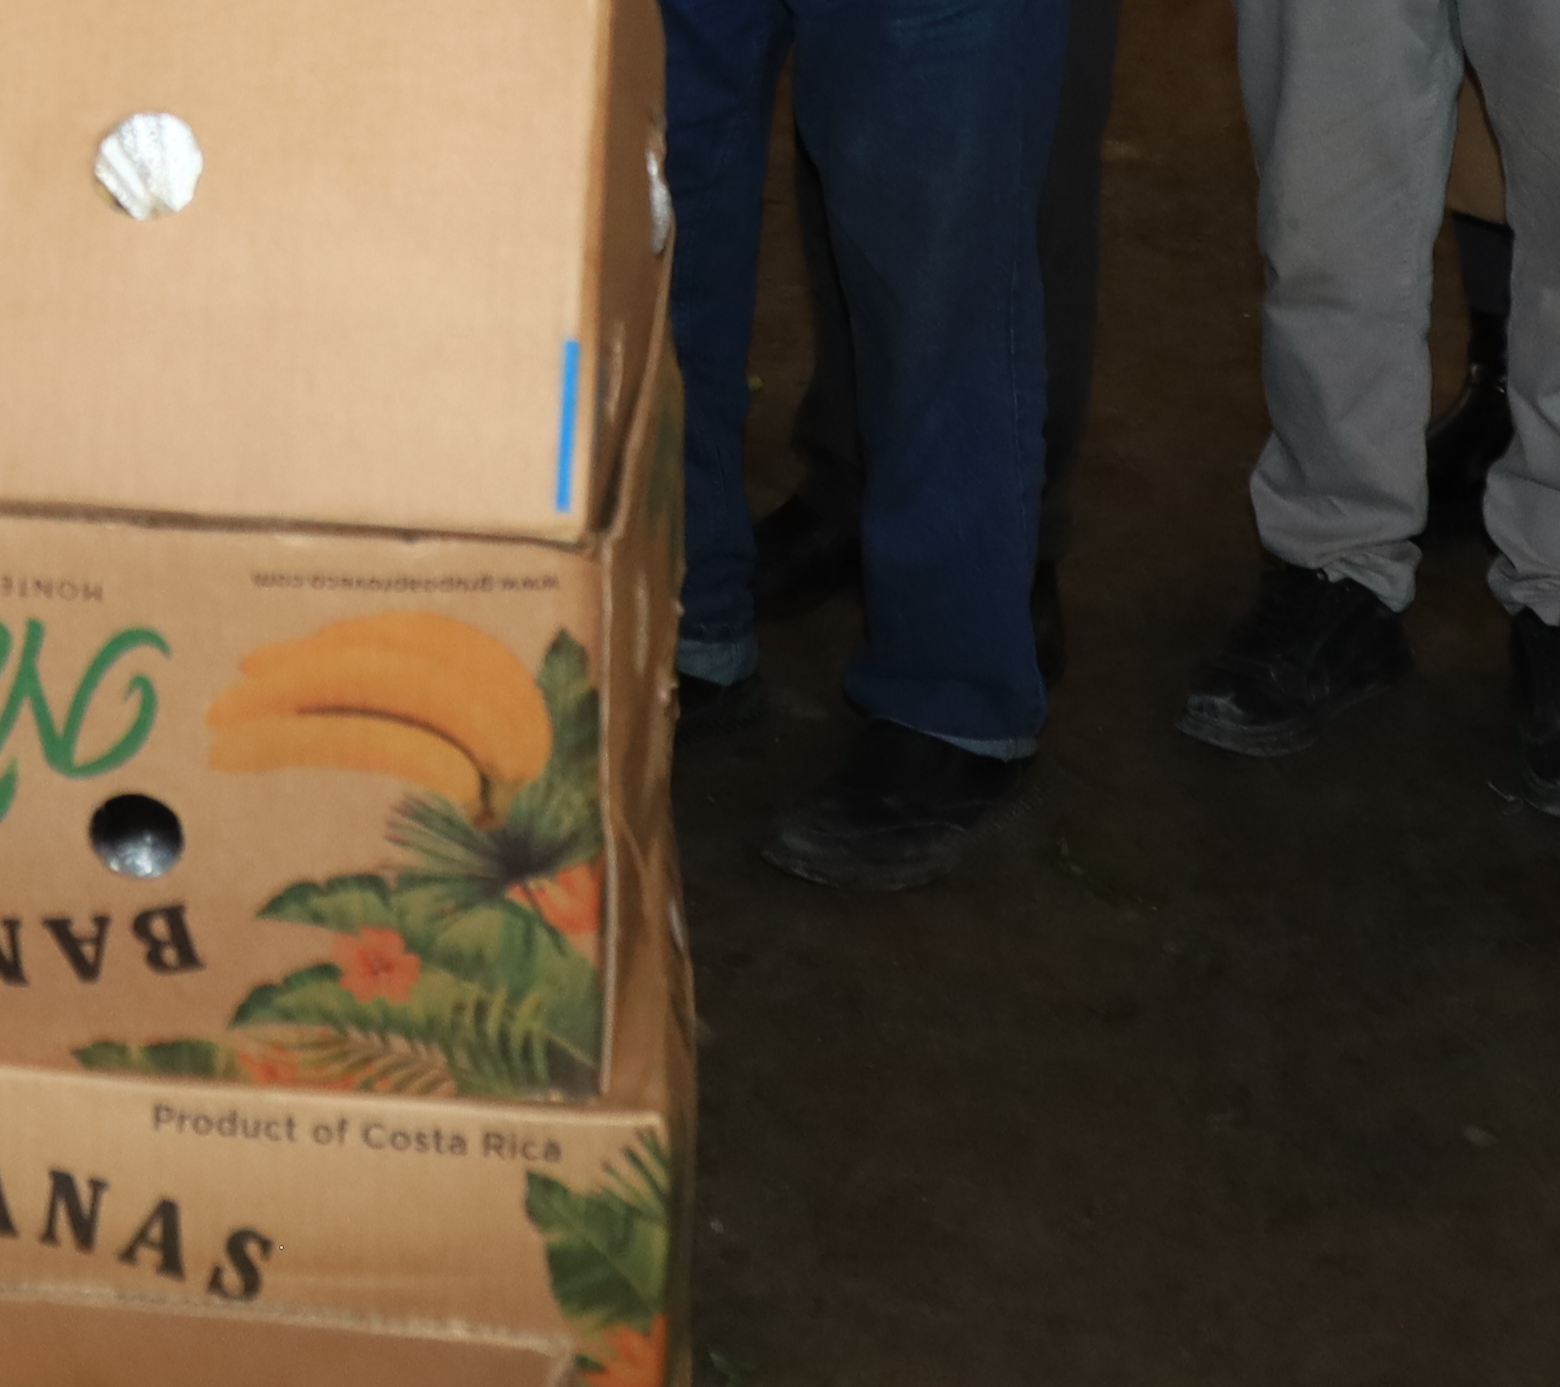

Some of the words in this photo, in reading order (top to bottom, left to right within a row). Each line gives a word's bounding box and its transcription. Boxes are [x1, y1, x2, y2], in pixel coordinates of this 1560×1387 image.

[152, 1104, 298, 1144] Product
[313, 1114, 352, 1147] of
[363, 1120, 470, 1158] Costa
[482, 1129, 564, 1164] Rica
